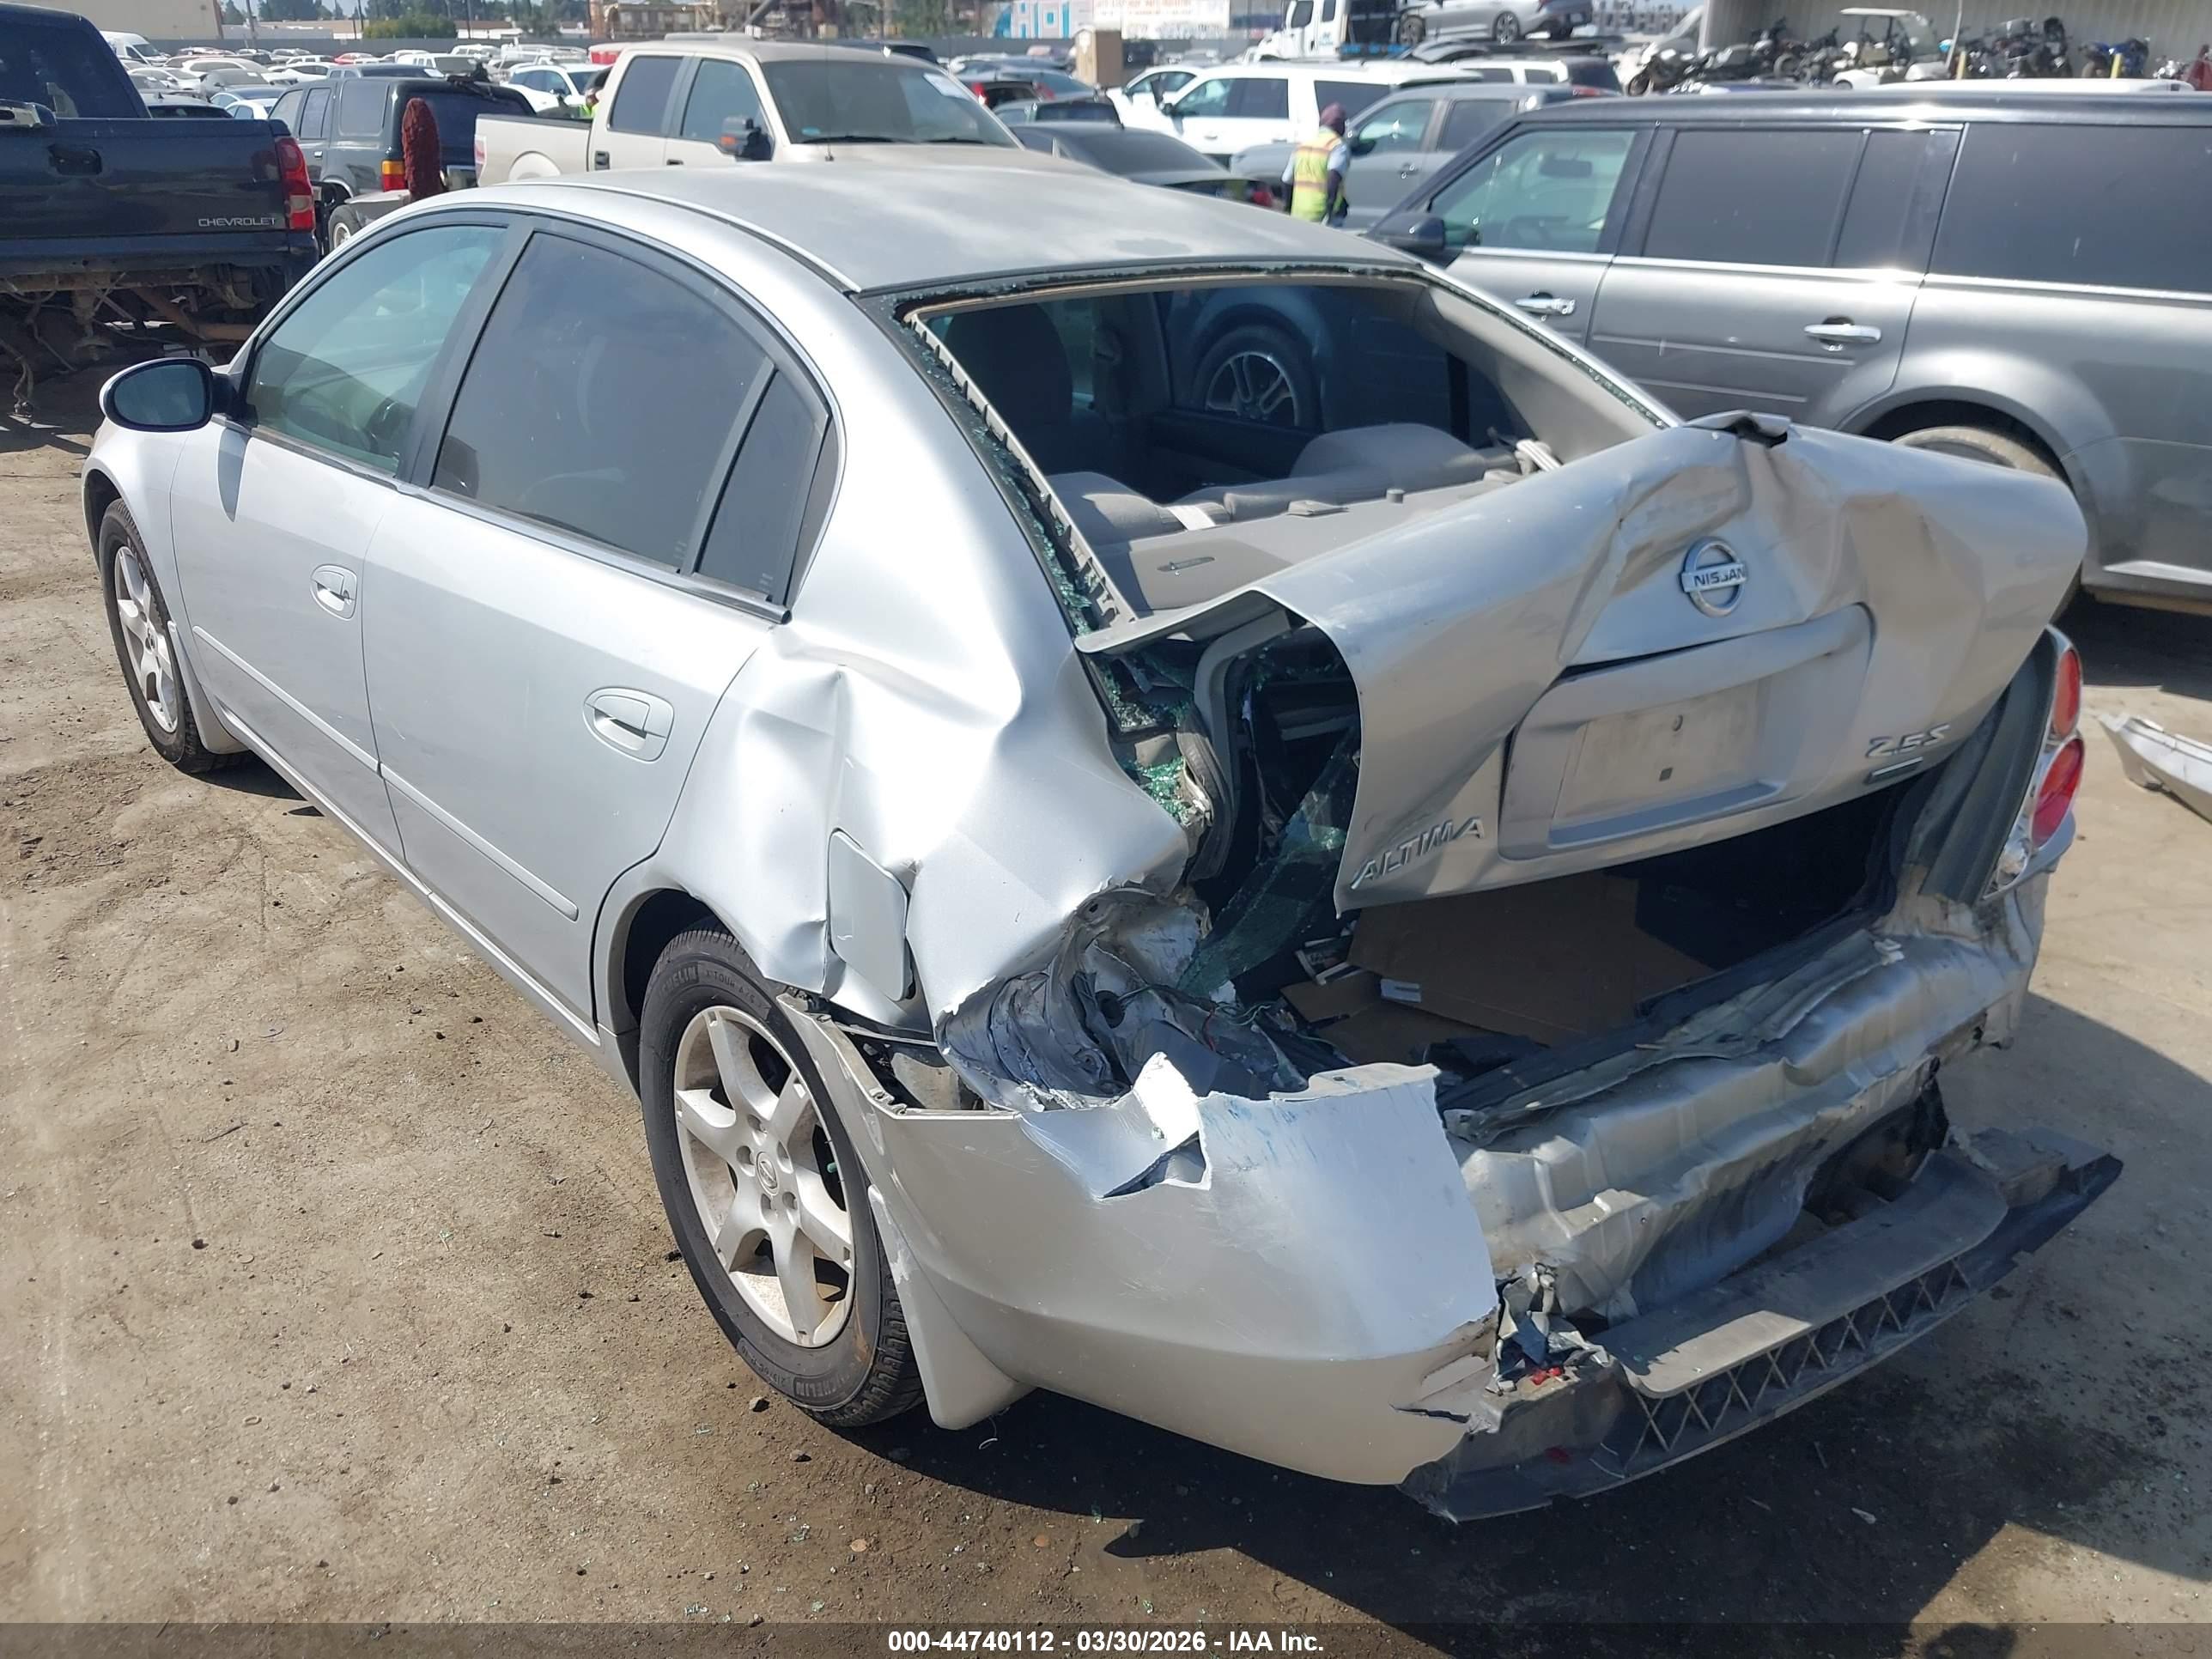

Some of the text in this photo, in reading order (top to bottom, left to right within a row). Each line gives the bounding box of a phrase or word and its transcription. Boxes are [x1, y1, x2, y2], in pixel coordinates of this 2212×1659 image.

[198, 216, 276, 227] CHEVROLET
[1693, 568, 1746, 586] NISSAN
[1350, 817, 1486, 890] ALTIMA
